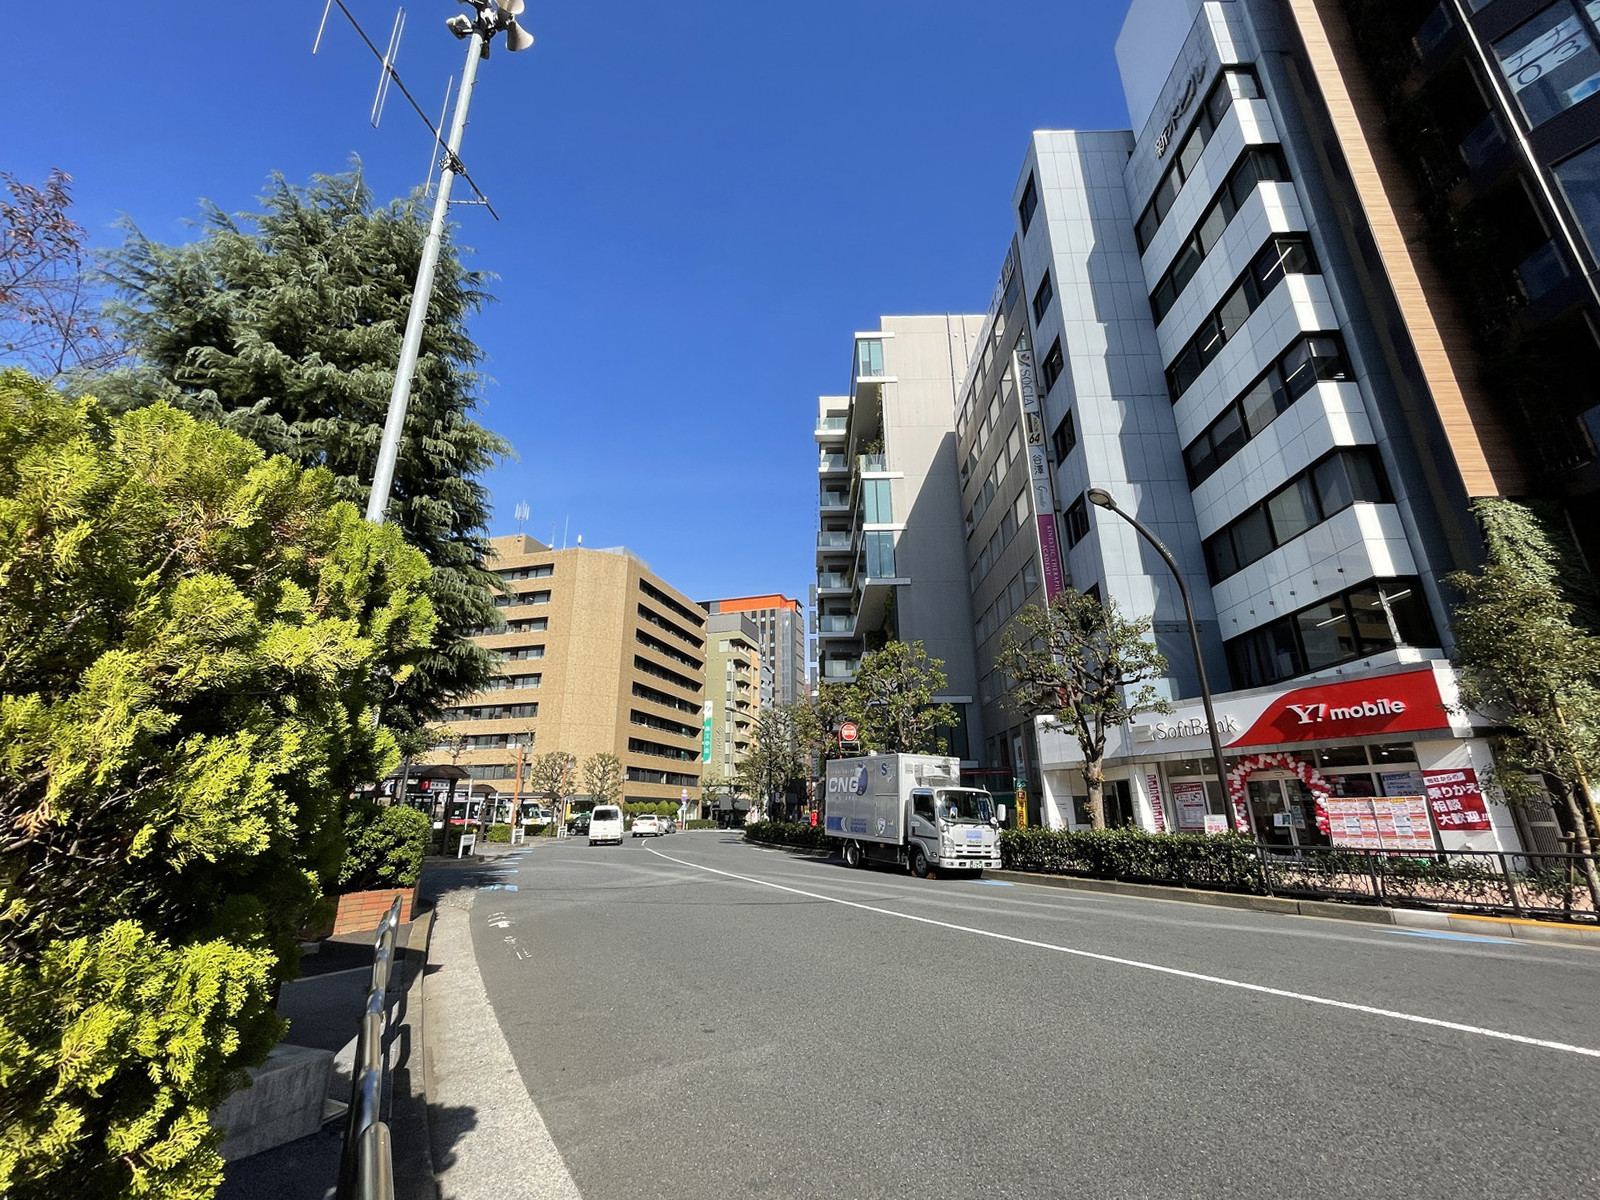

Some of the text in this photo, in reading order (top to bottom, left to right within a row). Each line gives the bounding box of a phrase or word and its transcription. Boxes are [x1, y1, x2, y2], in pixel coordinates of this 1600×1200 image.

[1021, 369, 1035, 408] SOCIA
[1030, 433, 1041, 444] 64
[1155, 714, 1237, 740] SoftBank
[828, 776, 859, 793] CNG
[1427, 782, 1481, 800] 乗りかえ
[1431, 798, 1463, 813] 相談
